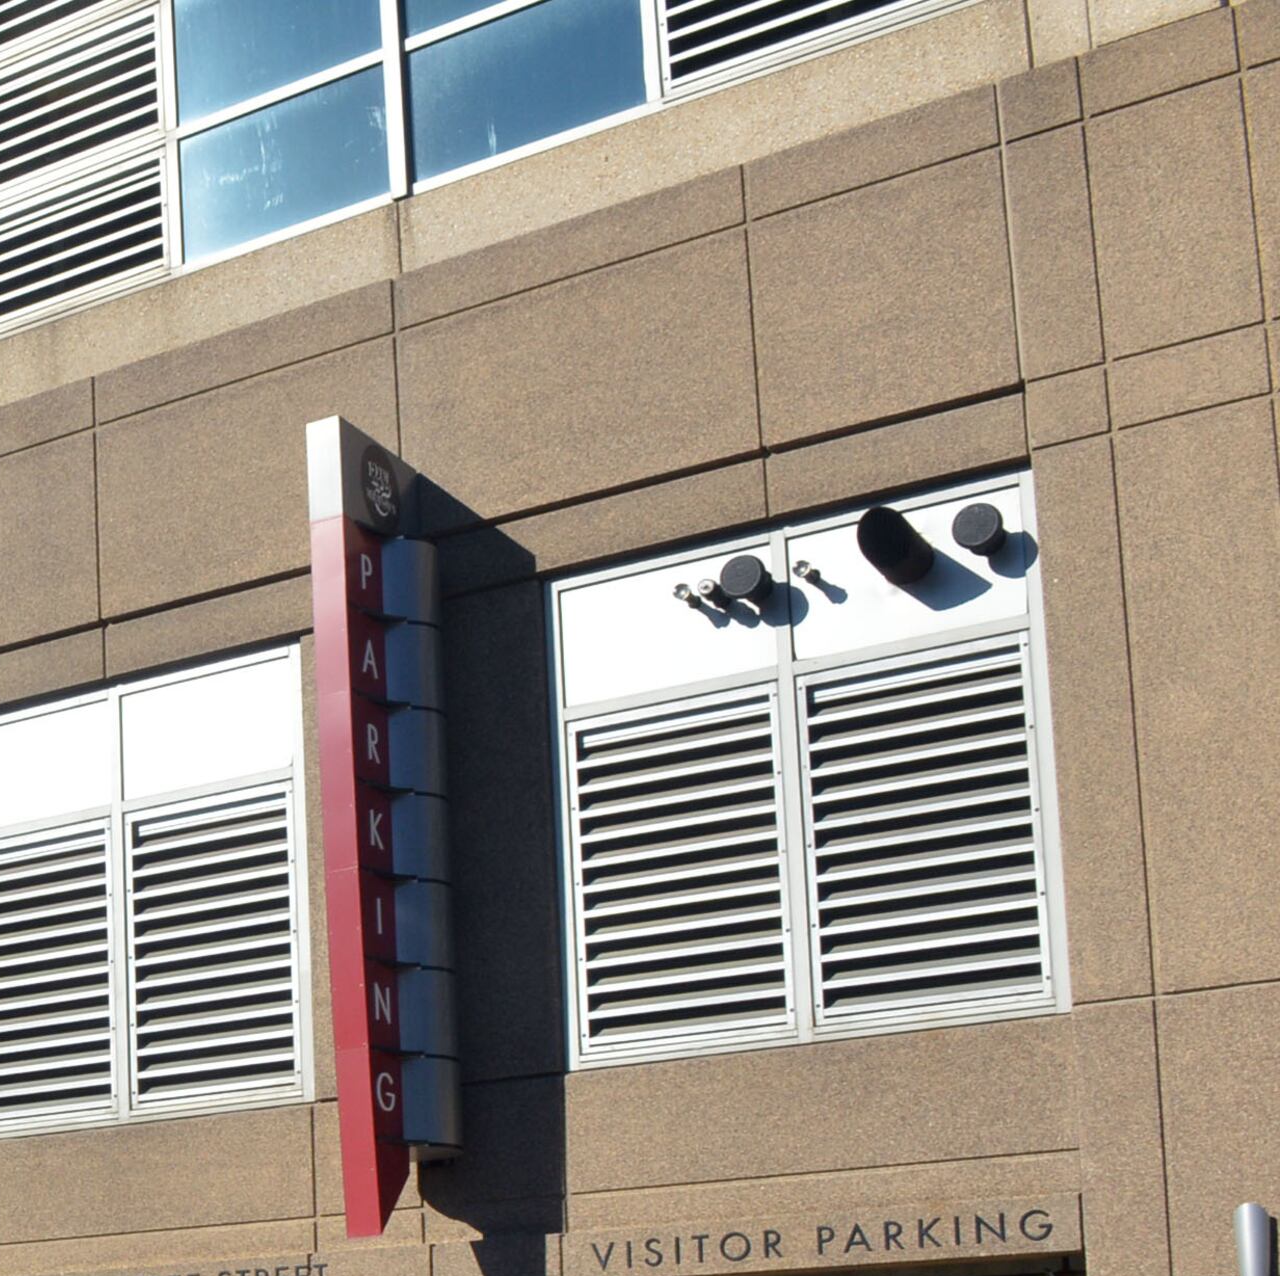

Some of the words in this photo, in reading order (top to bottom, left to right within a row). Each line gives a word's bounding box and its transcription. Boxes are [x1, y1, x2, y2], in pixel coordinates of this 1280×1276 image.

[359, 553, 396, 1112] PARKING
[591, 1229, 783, 1271] VISITOR
[816, 1209, 1054, 1255] PARKING
